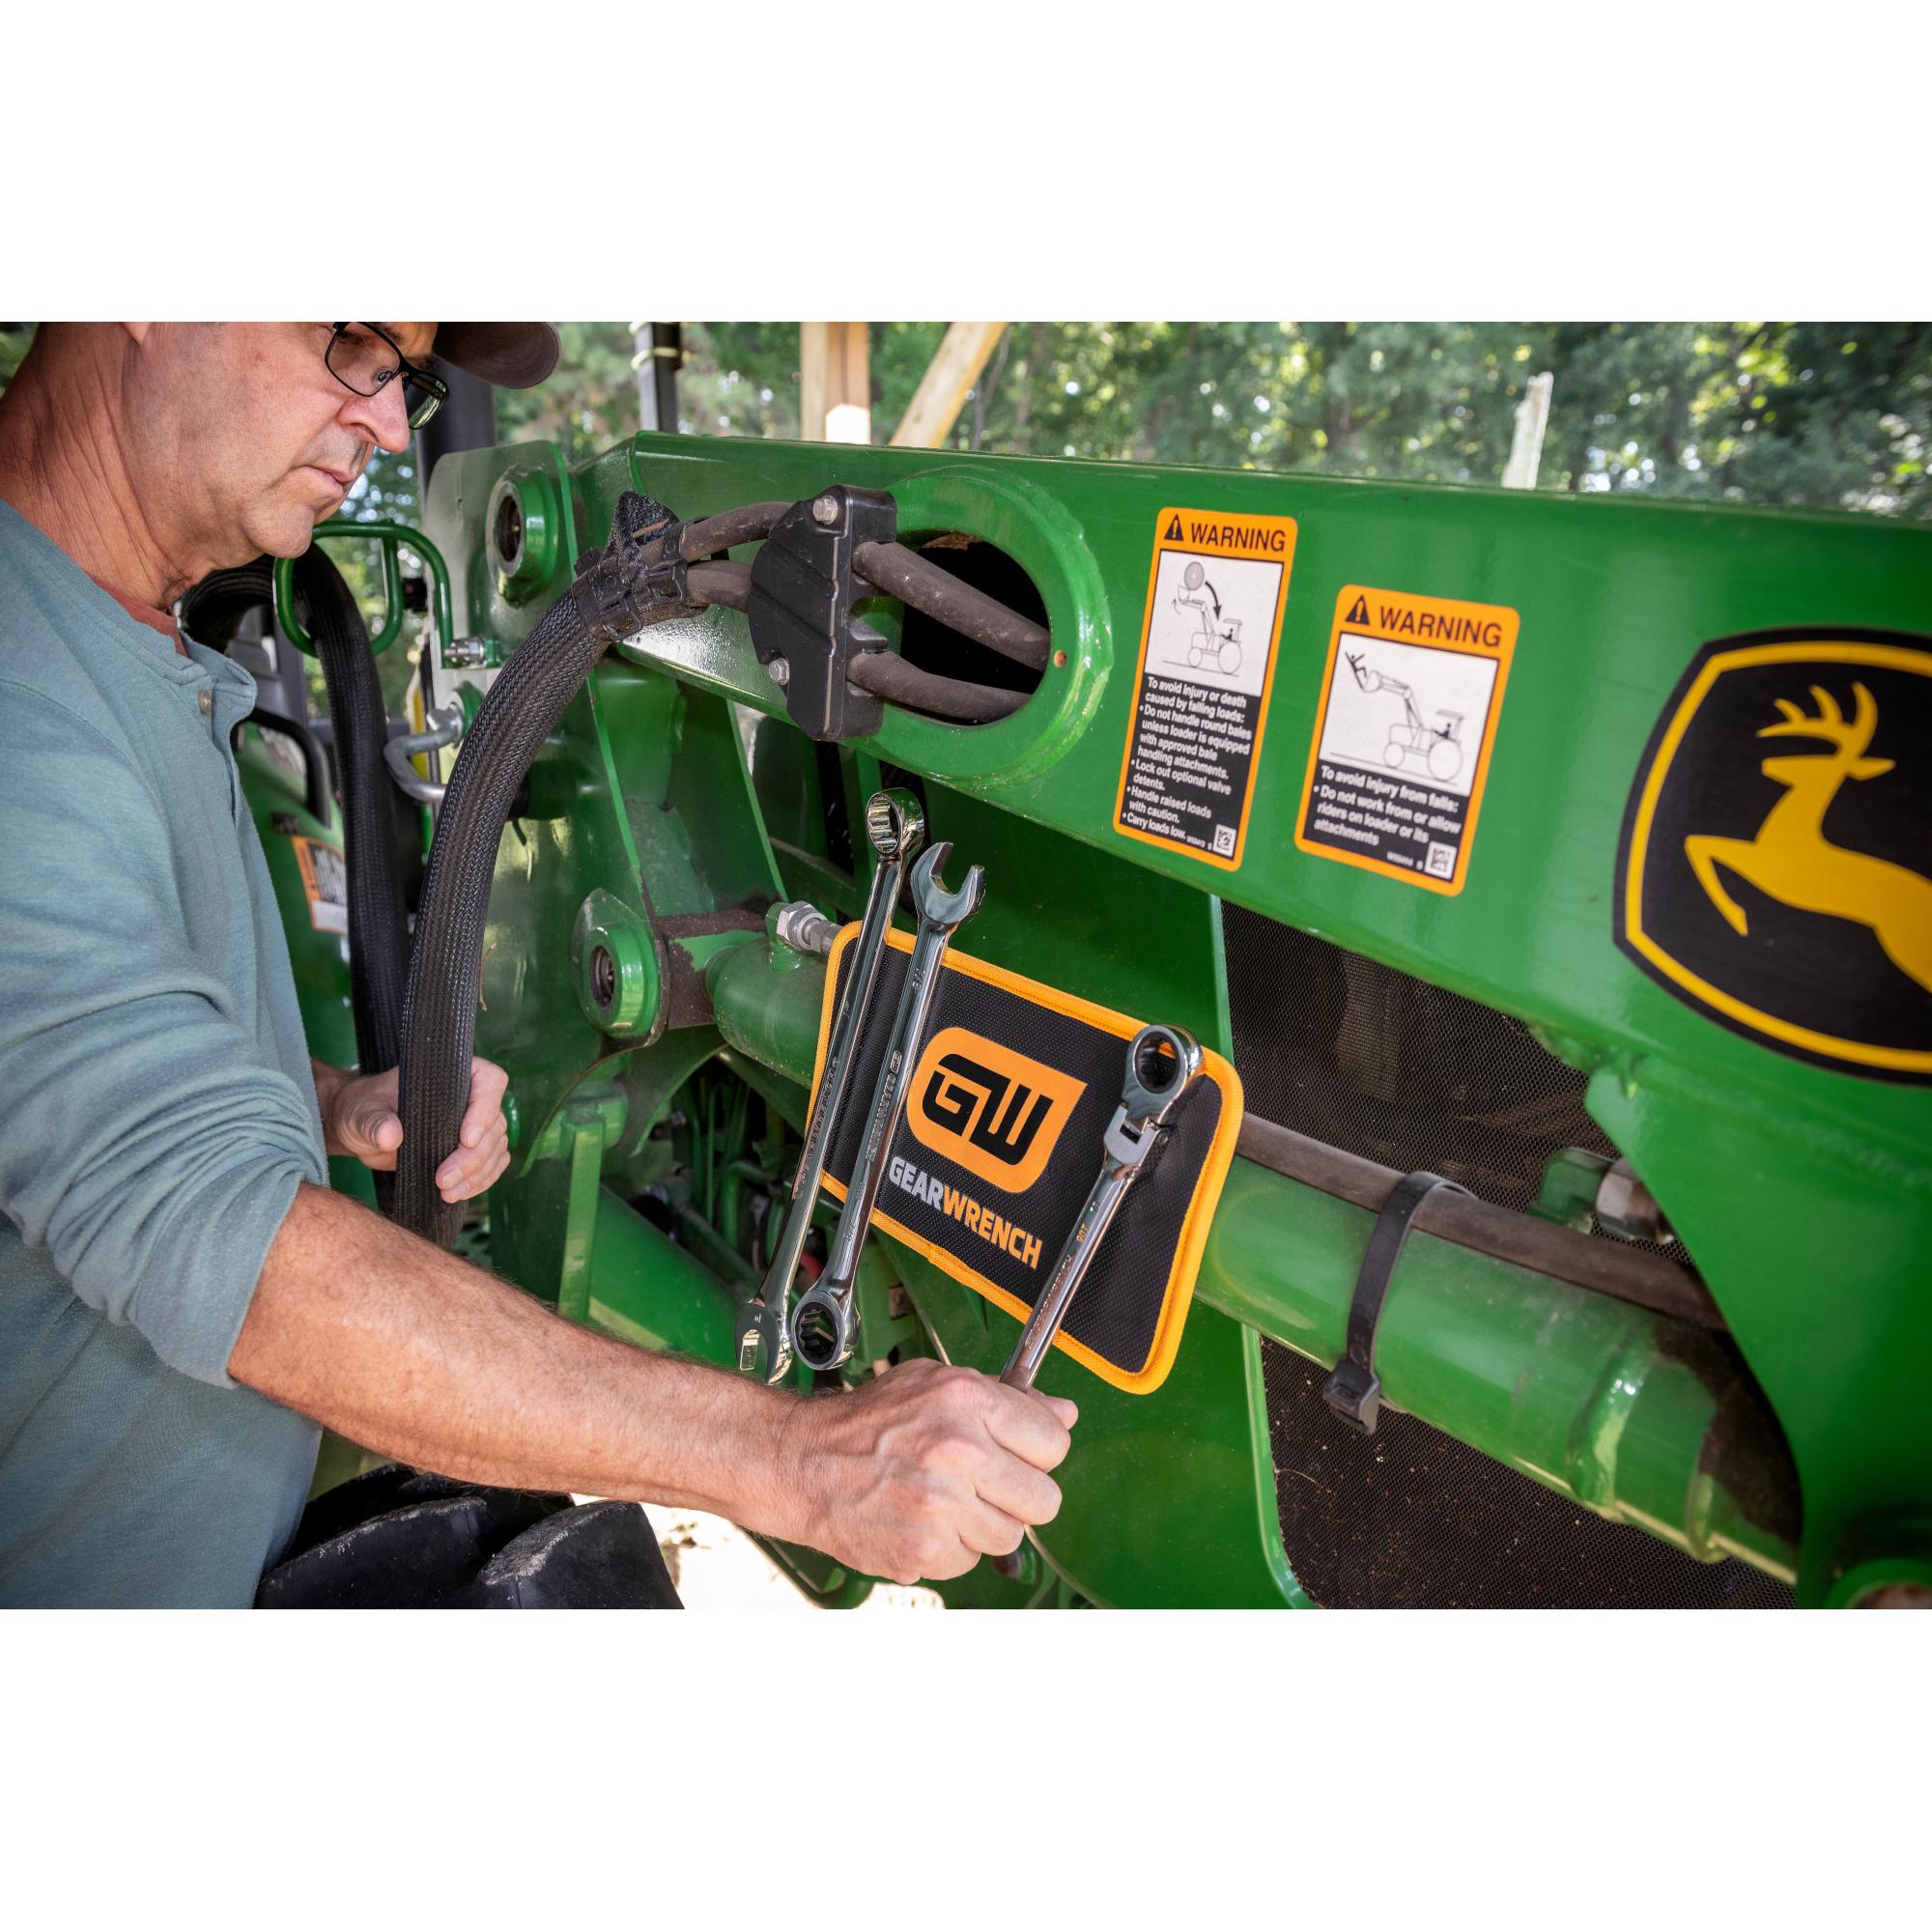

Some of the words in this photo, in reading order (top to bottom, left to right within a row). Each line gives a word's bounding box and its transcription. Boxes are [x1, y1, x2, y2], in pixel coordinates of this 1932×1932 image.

[1191, 523, 1286, 552] WARNING
[1379, 606, 1502, 647] WARNING
[1146, 694, 1175, 706] caused
[1176, 698, 1186, 711] by
[1188, 700, 1215, 718] falling
[1149, 676, 1157, 690] To
[1159, 681, 1181, 694] avoid
[1183, 685, 1208, 700] injury
[1209, 694, 1219, 702] or
[1221, 694, 1246, 708] death
[1142, 721, 1169, 734] unless
[1170, 725, 1198, 740] loader
[1198, 731, 1207, 743] is
[1208, 734, 1250, 754] equipped
[1144, 704, 1155, 717] Do
[1157, 709, 1170, 720] not
[1172, 711, 1200, 726] handle
[1201, 718, 1227, 733] round
[1228, 724, 1252, 740] bales
[1137, 746, 1172, 766] handling
[1140, 733, 1156, 746] with
[1158, 738, 1198, 755] approved
[1198, 747, 1217, 761] bale
[1133, 774, 1165, 791] detents.
[1136, 759, 1155, 774] Lock
[1156, 766, 1170, 778] out
[1172, 770, 1207, 787] optional
[1208, 780, 1232, 795] valve
[1321, 765, 1334, 780] To
[1335, 772, 1365, 787] avoid
[1366, 777, 1399, 799] injury
[1400, 785, 1428, 805] from
[1129, 800, 1146, 813] with
[1148, 806, 1179, 823] caution.
[1131, 786, 1158, 803] Handle
[1160, 796, 1186, 810] raised
[1187, 801, 1211, 818] loads
[1321, 784, 1336, 799] Do
[1337, 790, 1355, 805] not
[1357, 797, 1384, 812] work
[1385, 801, 1413, 821] from
[1413, 811, 1428, 824] or
[1428, 815, 1462, 835] allow
[1127, 812, 1148, 829] Carry
[1148, 817, 1170, 835] loads
[1317, 802, 1348, 820] riders
[1349, 810, 1363, 823] on
[1364, 813, 1399, 834] loader
[1399, 825, 1413, 838] or
[1413, 828, 1430, 843] its
[923, 1053, 1054, 1166] GW
[890, 1156, 1042, 1269] GEARWRENCH
